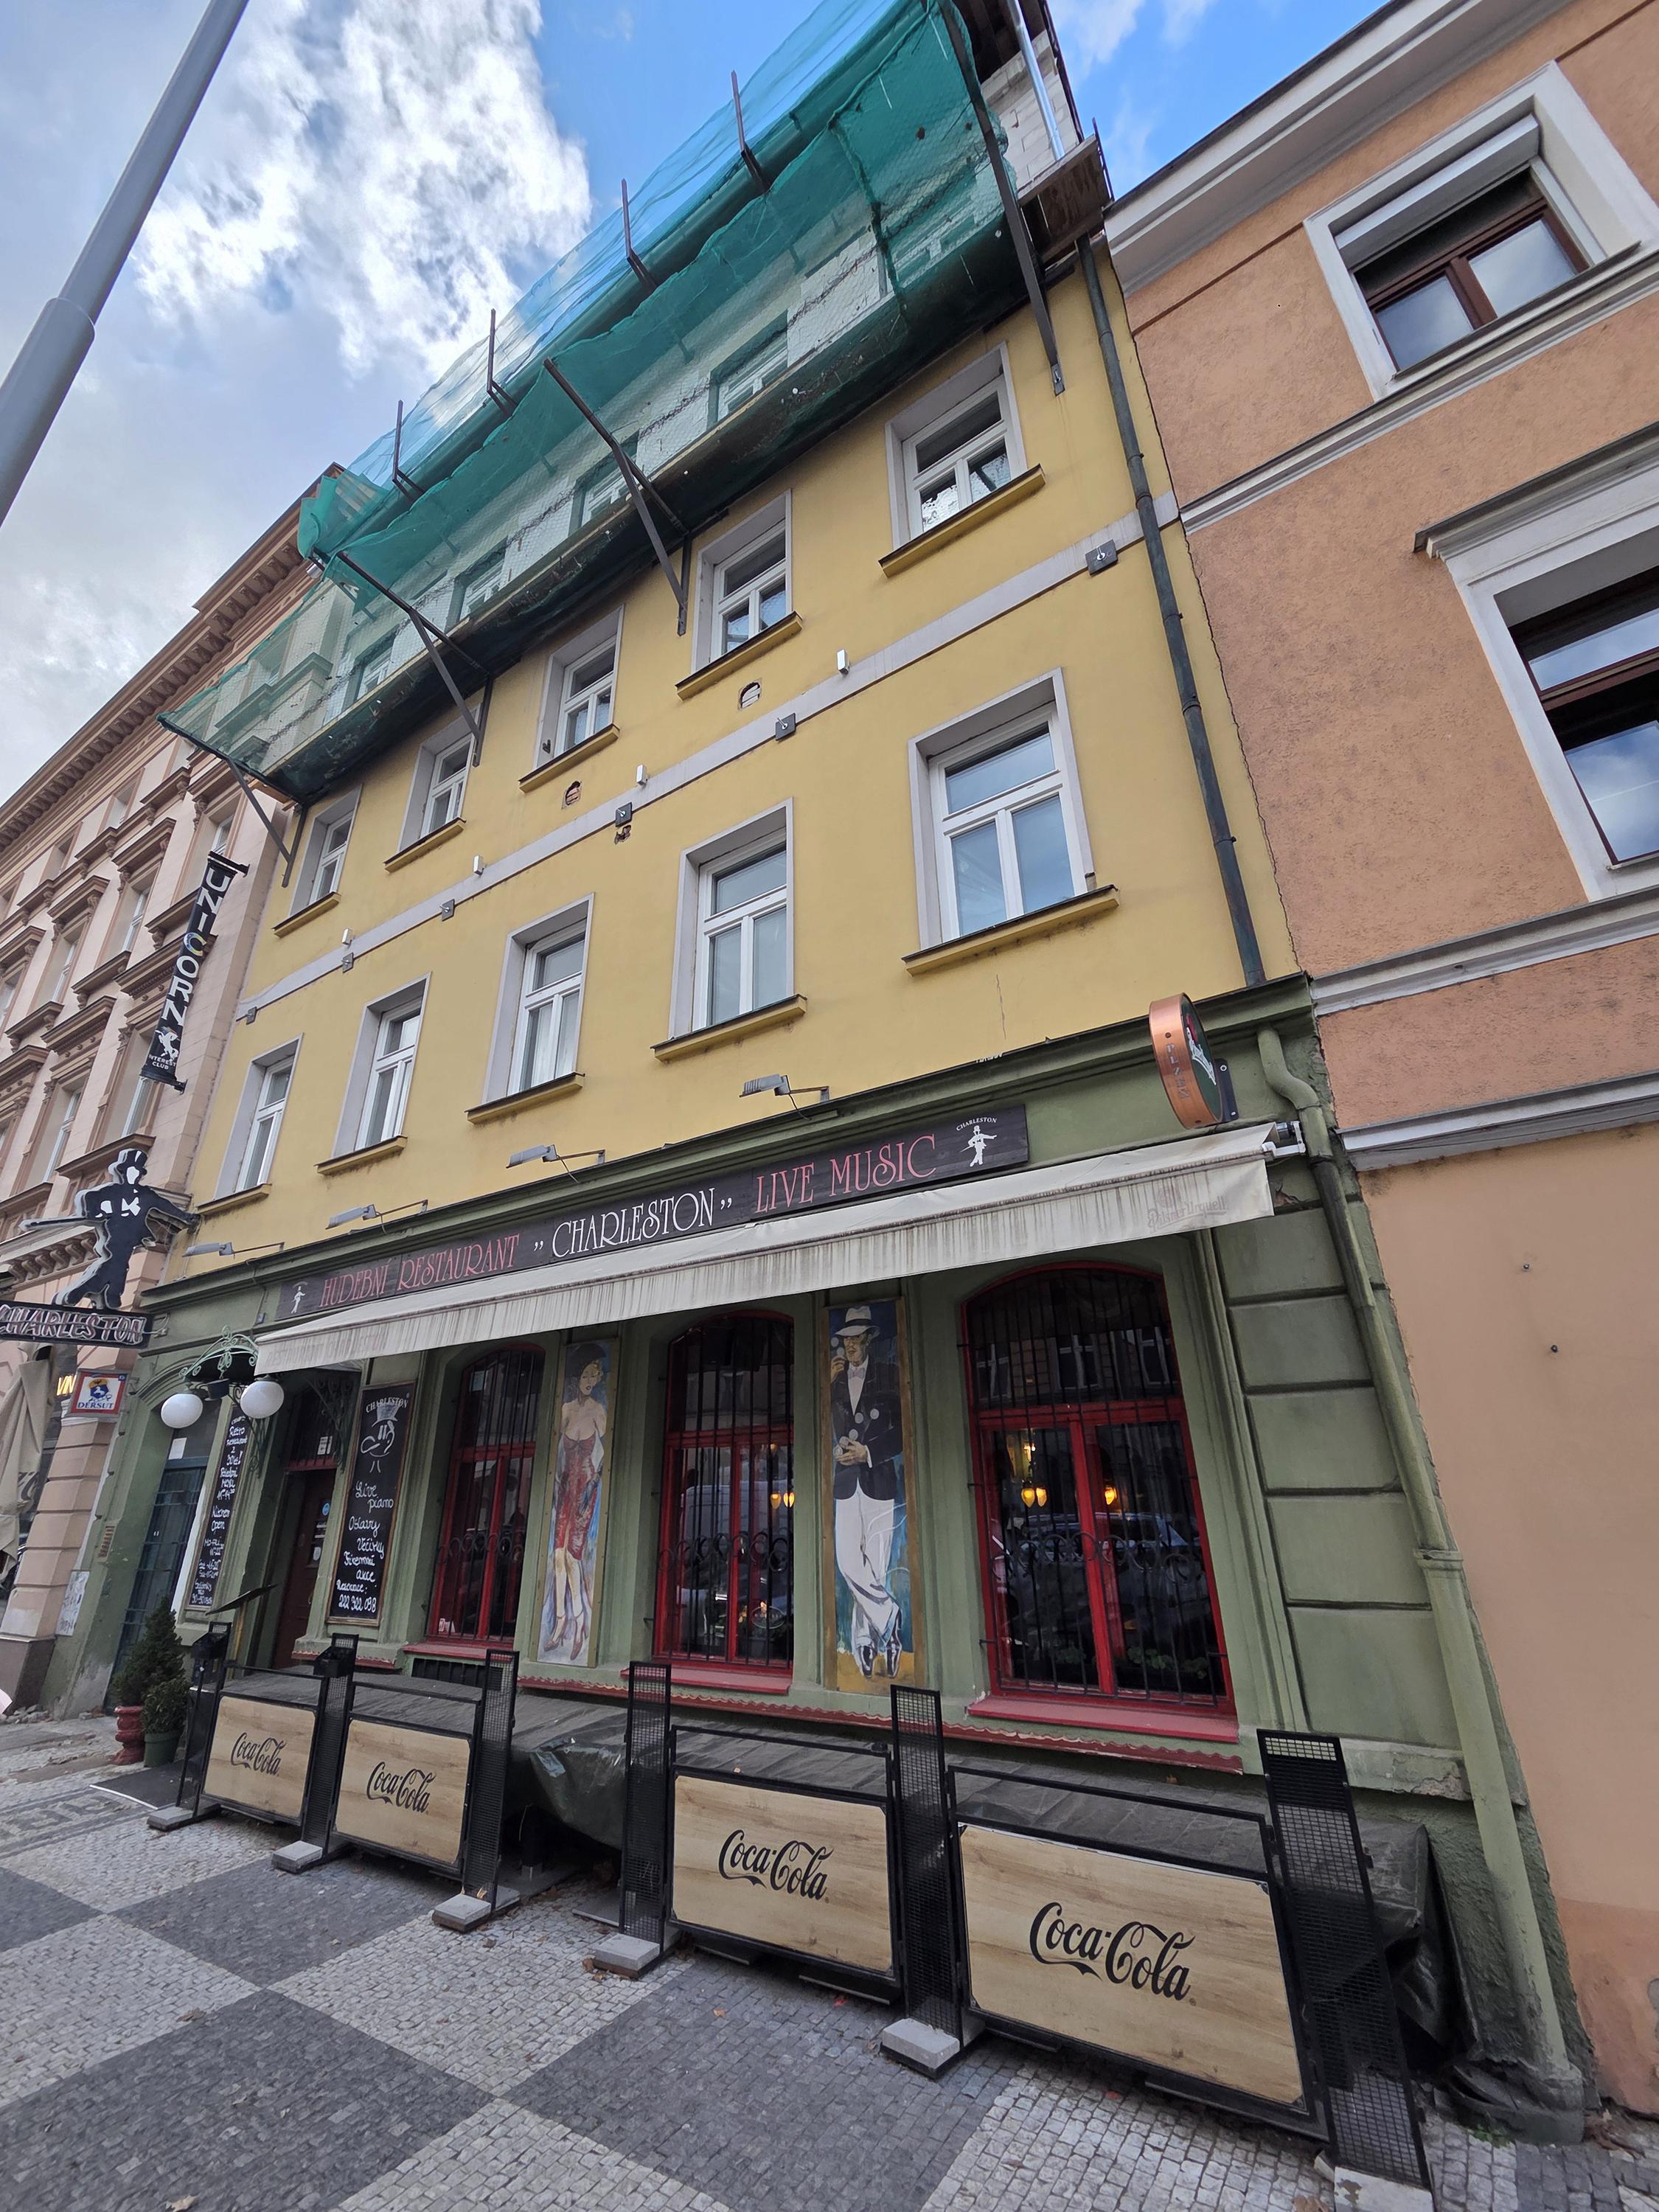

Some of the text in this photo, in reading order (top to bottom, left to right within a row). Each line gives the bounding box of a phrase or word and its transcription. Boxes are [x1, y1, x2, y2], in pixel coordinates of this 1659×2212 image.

[161, 868, 230, 1027] UNICORN
[148, 1054, 177, 1067] INTEREST
[152, 1062, 169, 1070] CLUB
[956, 1116, 997, 1131] CHARLESTON
[1185, 1196, 1226, 1218] Urquell
[319, 1258, 391, 1307] HUDEBNÍ
[397, 1234, 519, 1290] RESTAURANT
[755, 1163, 815, 1213] LIVE
[830, 1134, 936, 1197] MUSIC
[366, 1397, 408, 1413] CHARLESTON
[355, 1481, 378, 1498] Live
[367, 1498, 394, 1514] piano
[348, 1516, 380, 1538] Oslavy
